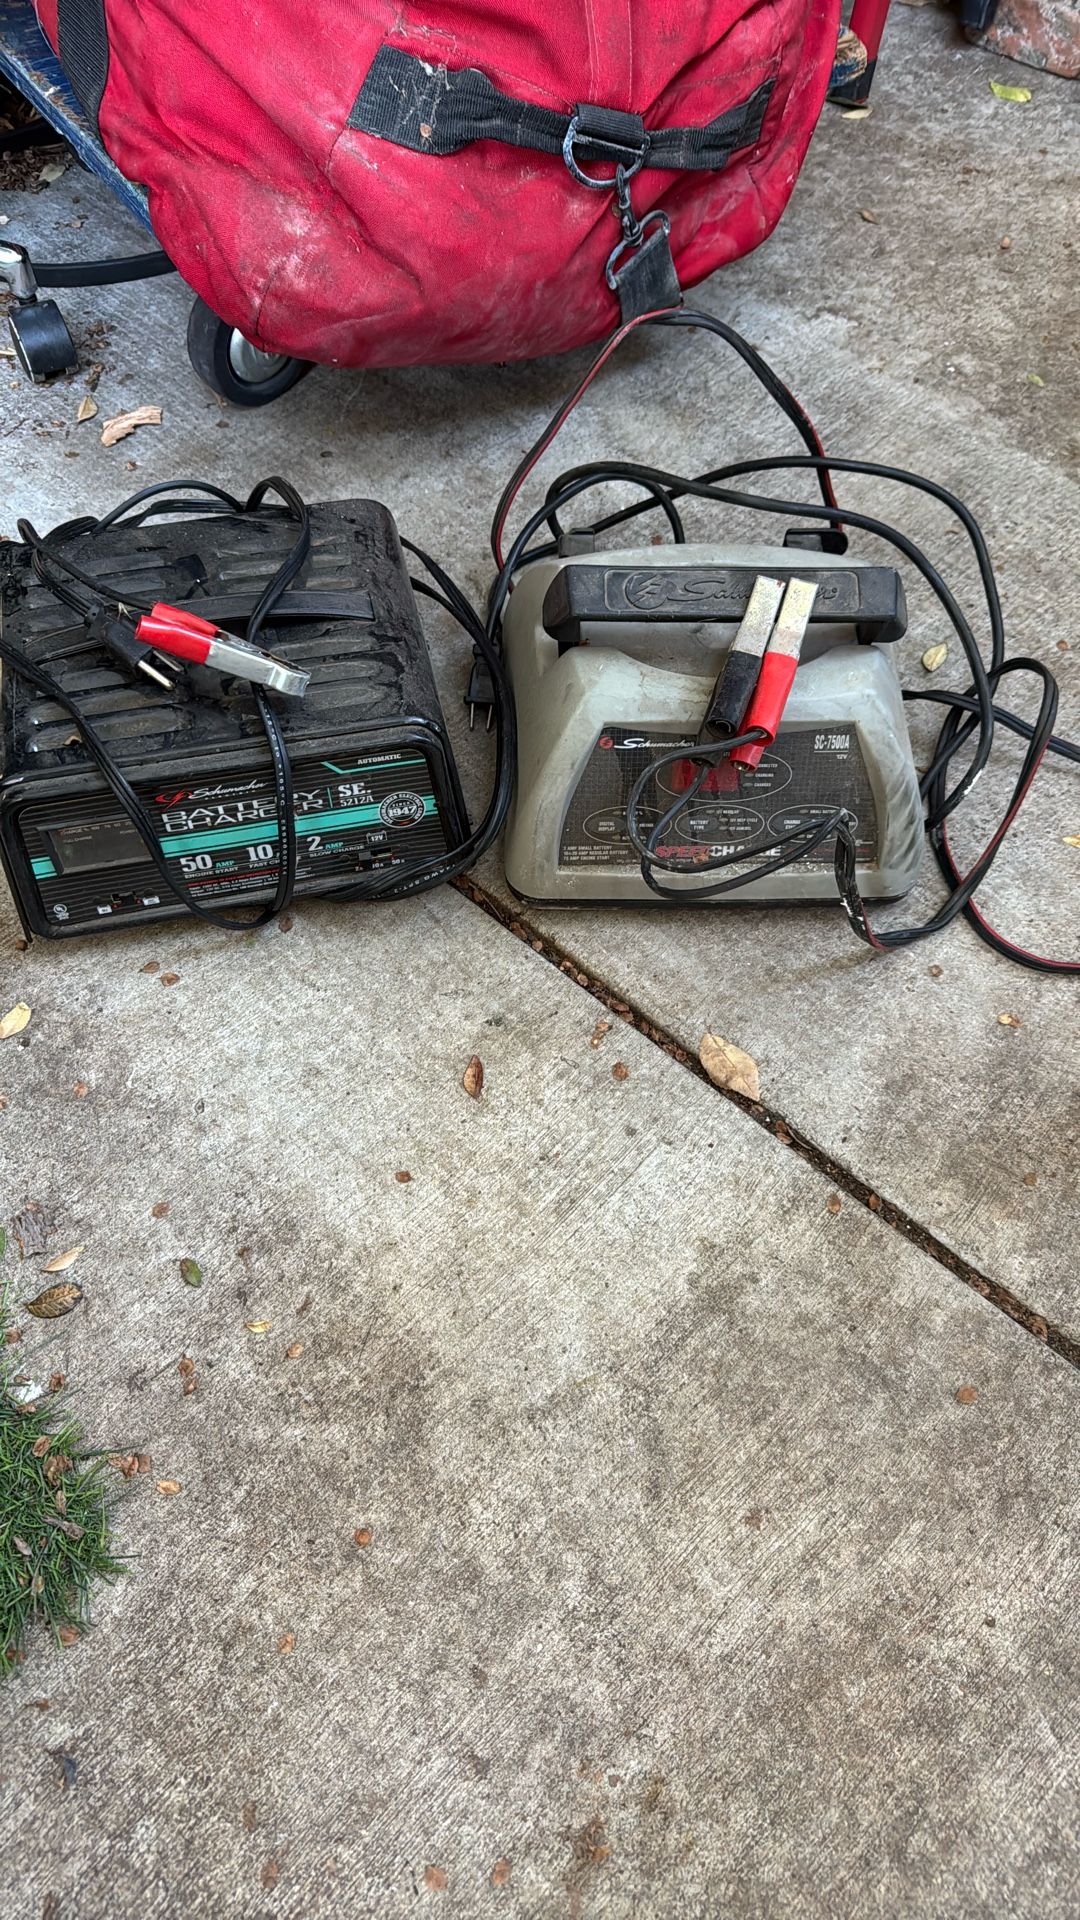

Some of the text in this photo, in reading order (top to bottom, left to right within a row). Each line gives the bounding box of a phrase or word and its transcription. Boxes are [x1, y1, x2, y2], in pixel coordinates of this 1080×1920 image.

[614, 737, 695, 750] Schumacher
[814, 734, 850, 750] SC-7500A
[357, 753, 402, 765] AUTOMATIC
[188, 779, 268, 800] Schumacher
[340, 795, 374, 807] 5212A
[165, 799, 324, 833] CHARGR
[388, 805, 417, 817] 1947
[306, 836, 344, 851] 2 AMP
[371, 834, 384, 842] 12V
[246, 844, 274, 861] 10
[310, 845, 365, 858] SLOW CHARGE
[655, 845, 781, 857] SPEECHE
[180, 854, 235, 873] 50 AMP
[249, 861, 268, 869] FAST
[184, 866, 239, 879] ENGINE START
